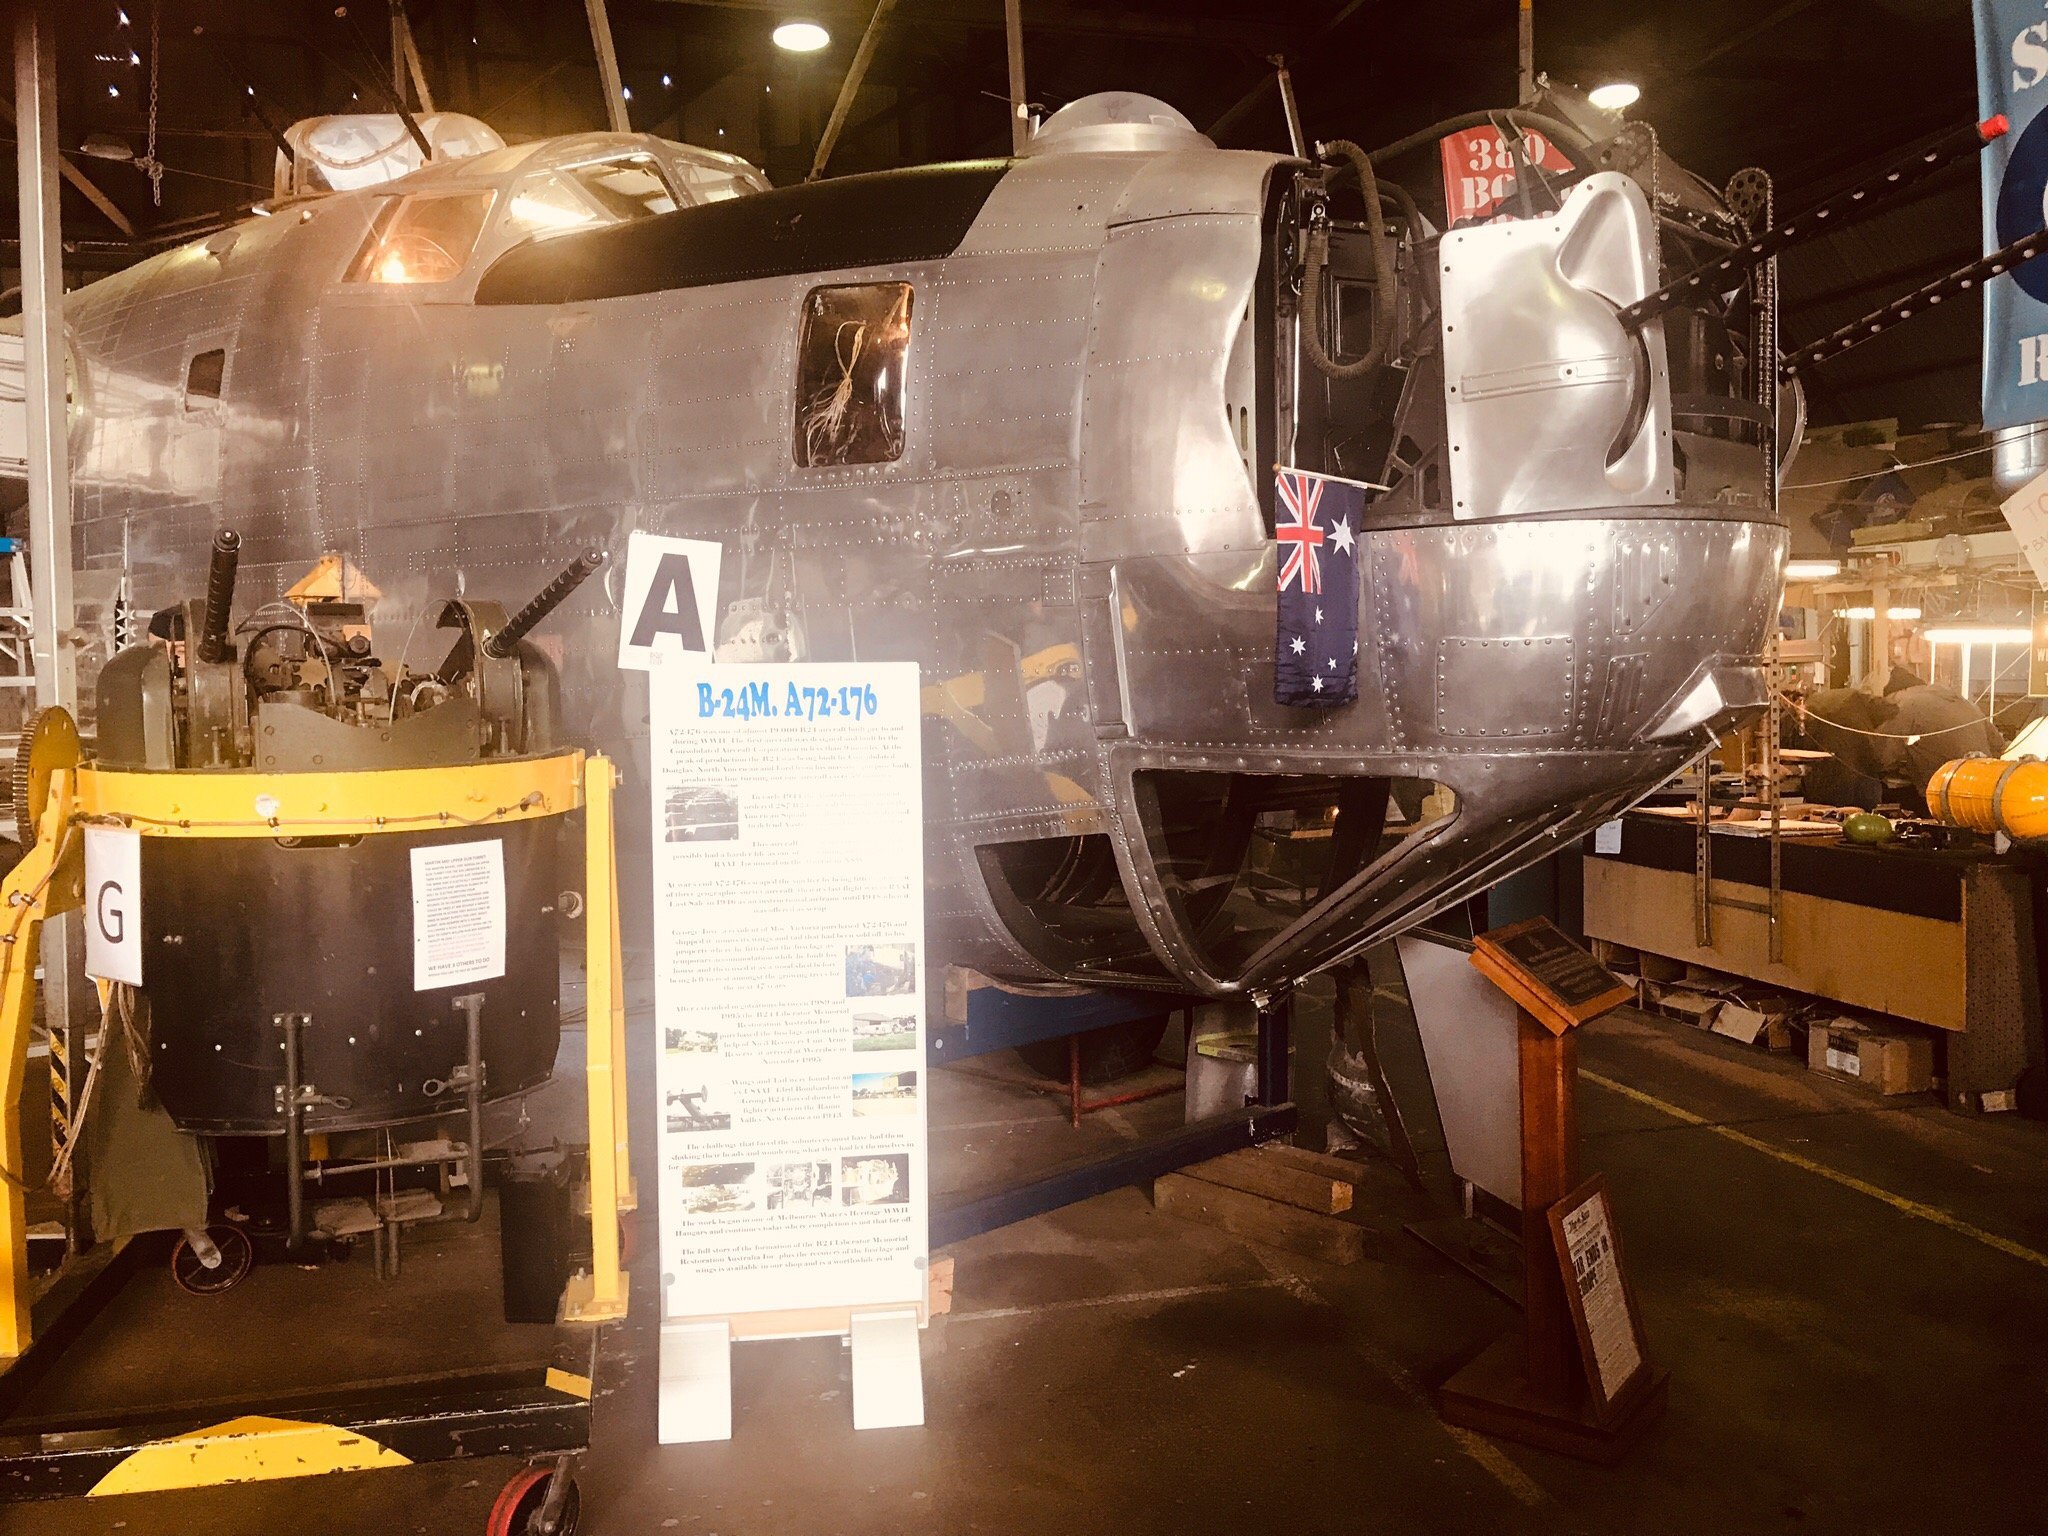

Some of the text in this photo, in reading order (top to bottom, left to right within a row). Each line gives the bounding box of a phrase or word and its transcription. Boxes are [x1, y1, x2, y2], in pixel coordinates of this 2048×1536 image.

[1469, 134, 1546, 171] 380
[629, 552, 706, 652] A
[784, 681, 878, 721] A72-176
[97, 880, 124, 944] G
